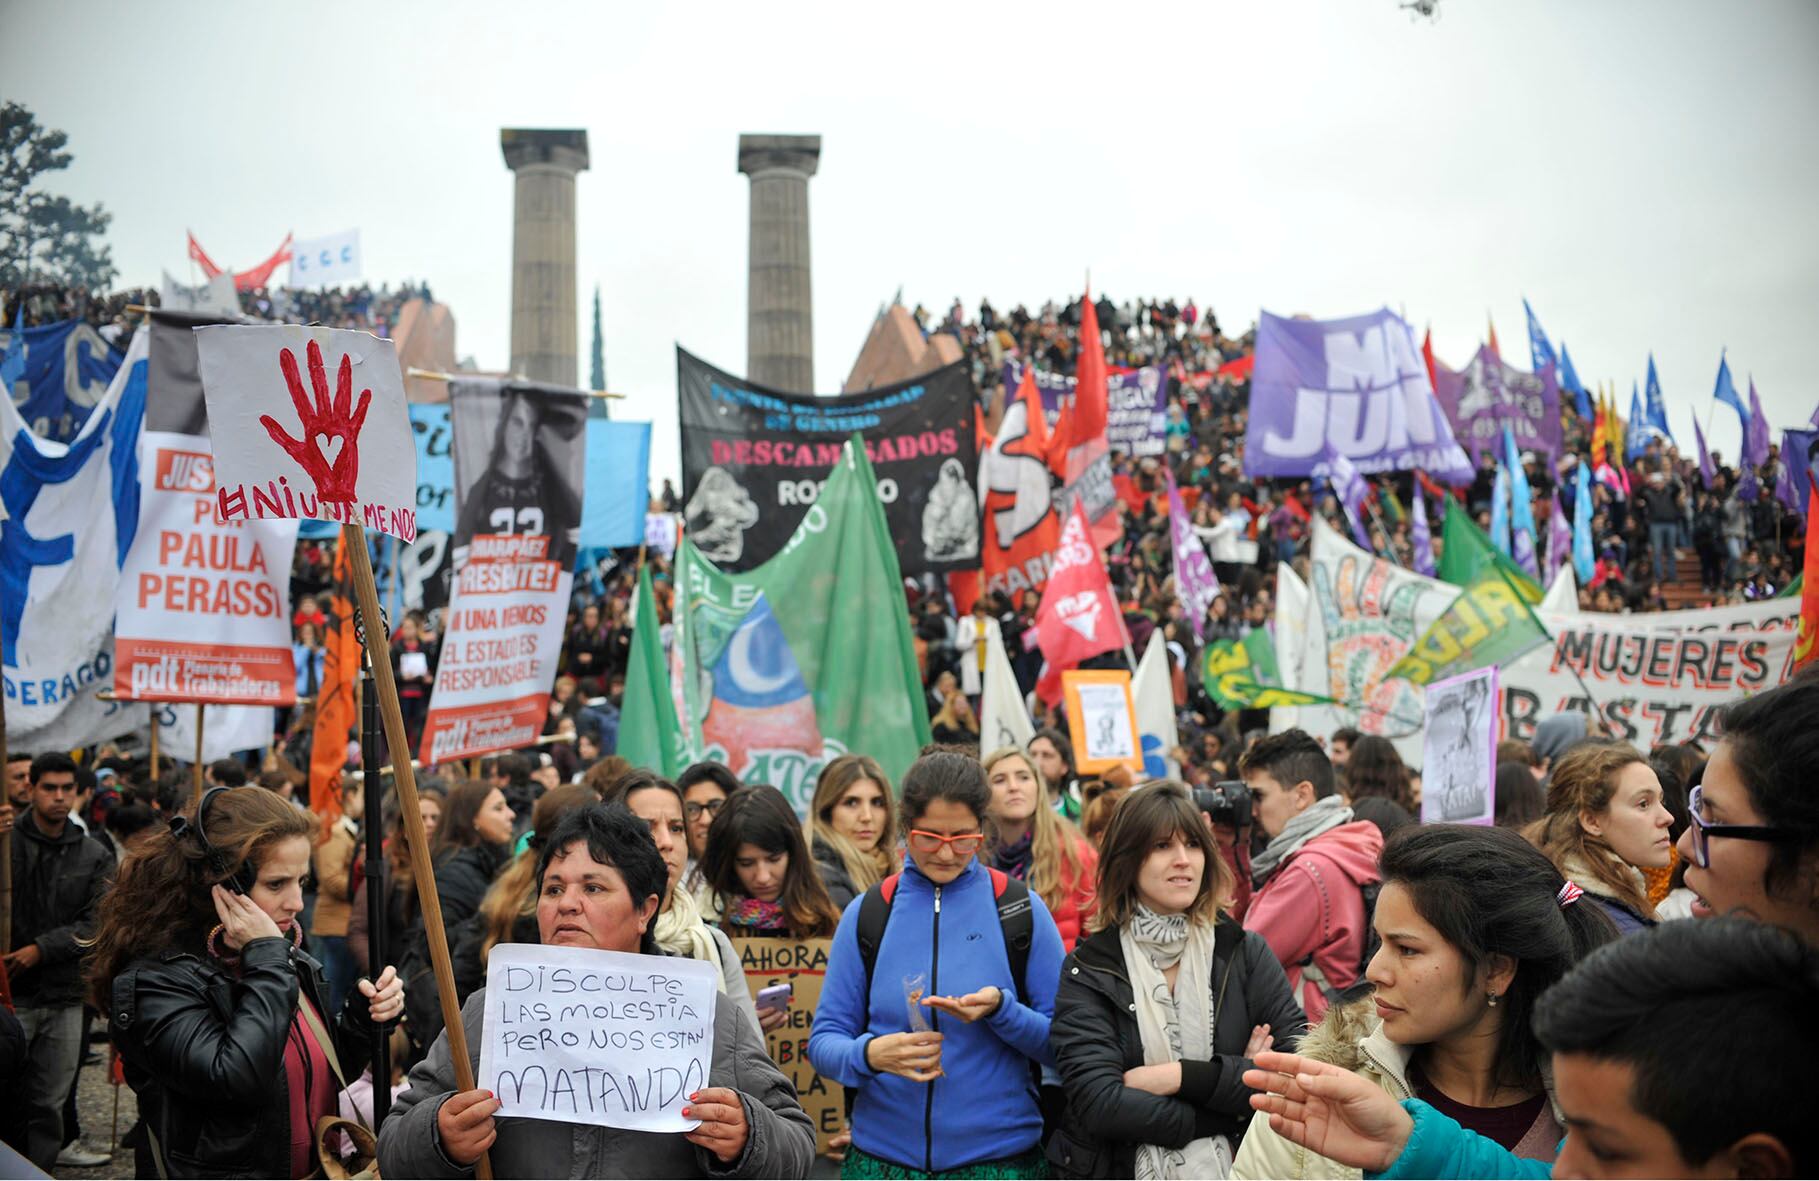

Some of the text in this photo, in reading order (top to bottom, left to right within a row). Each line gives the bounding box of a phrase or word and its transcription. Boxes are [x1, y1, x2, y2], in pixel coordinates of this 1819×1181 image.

[711, 429, 959, 466] DESCAMSADOS
[162, 454, 214, 491] JUS
[159, 531, 267, 575] PAULA
[137, 573, 283, 619] PERASSI
[1550, 630, 1768, 690] MUJERES
[741, 944, 829, 971] AHORA
[502, 1001, 552, 1024] LAS
[502, 1028, 704, 1057] PERO NOS ESTAN
[497, 1058, 704, 1113] MATANDO
